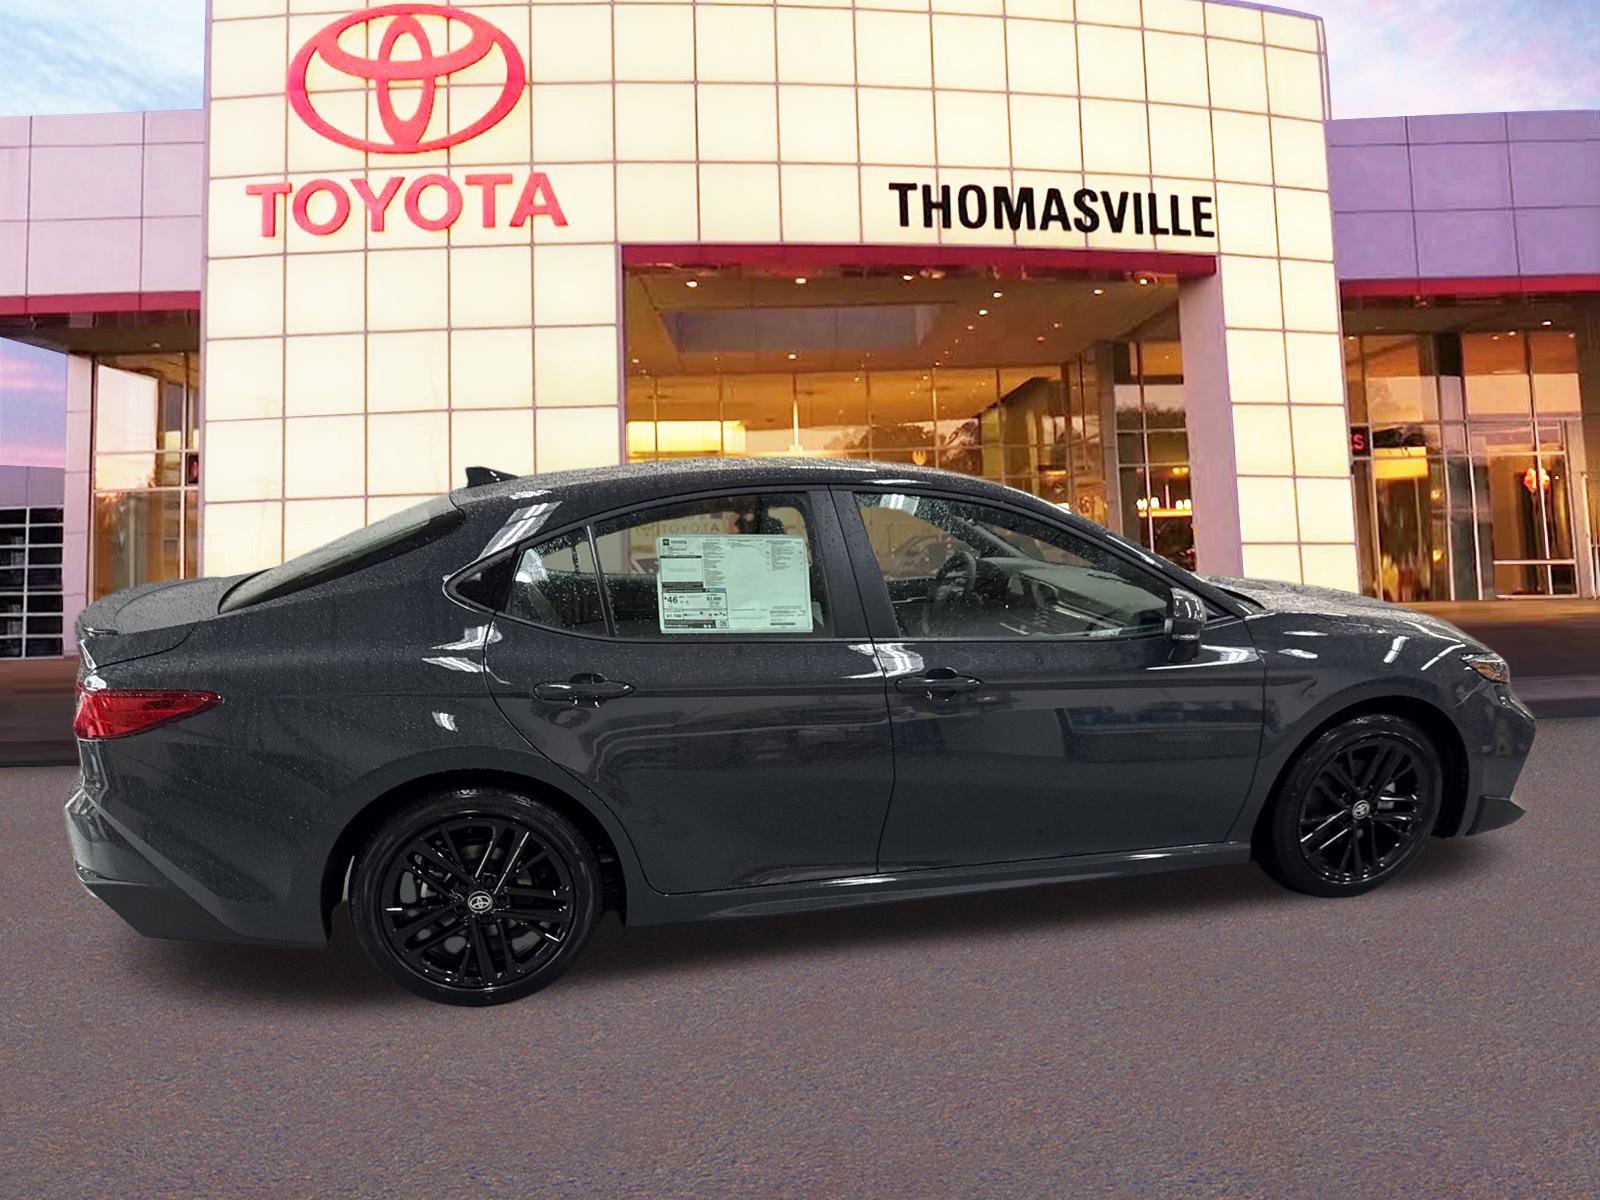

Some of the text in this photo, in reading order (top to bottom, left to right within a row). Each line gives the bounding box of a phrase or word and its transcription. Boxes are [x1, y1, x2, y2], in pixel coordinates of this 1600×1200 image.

[246, 172, 569, 238] TOYOTA
[888, 182, 1216, 238] THOMASVILLE
[662, 522, 720, 534] TOYOTA
